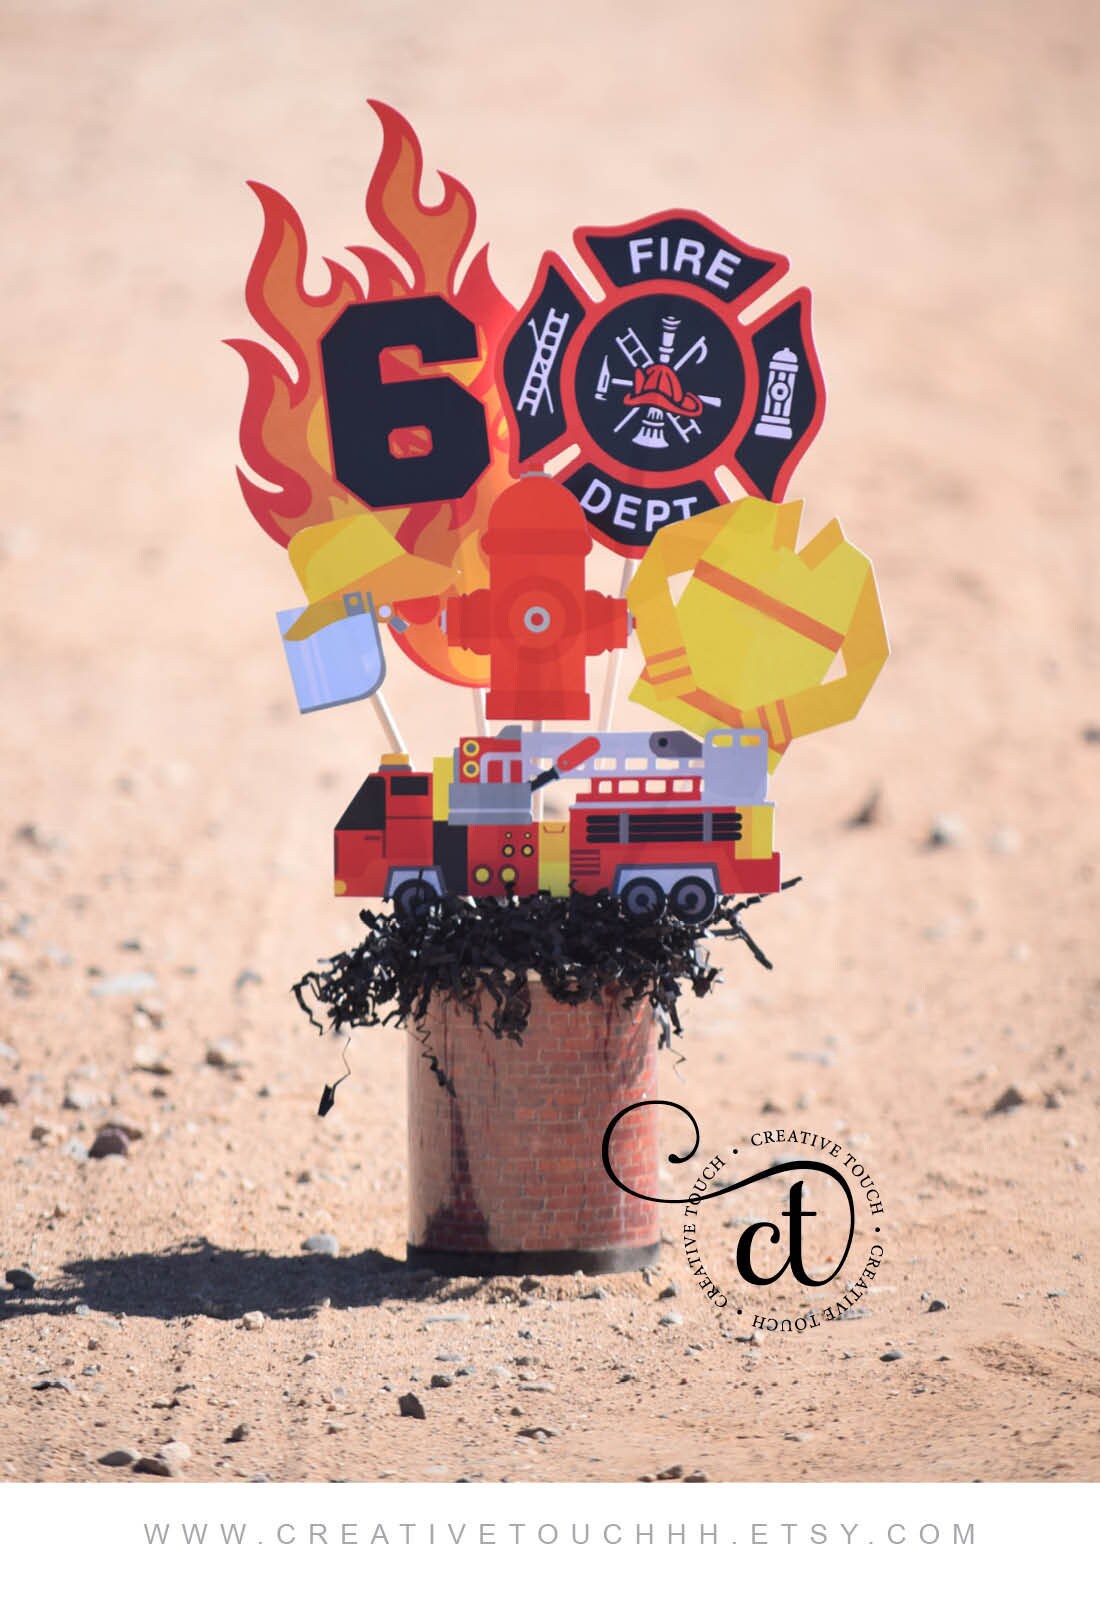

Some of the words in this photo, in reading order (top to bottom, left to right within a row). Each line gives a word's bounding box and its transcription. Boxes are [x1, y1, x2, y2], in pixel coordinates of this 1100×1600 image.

[628, 236, 742, 289] FIRE
[320, 295, 492, 508] 6
[580, 478, 698, 532] DEPT
